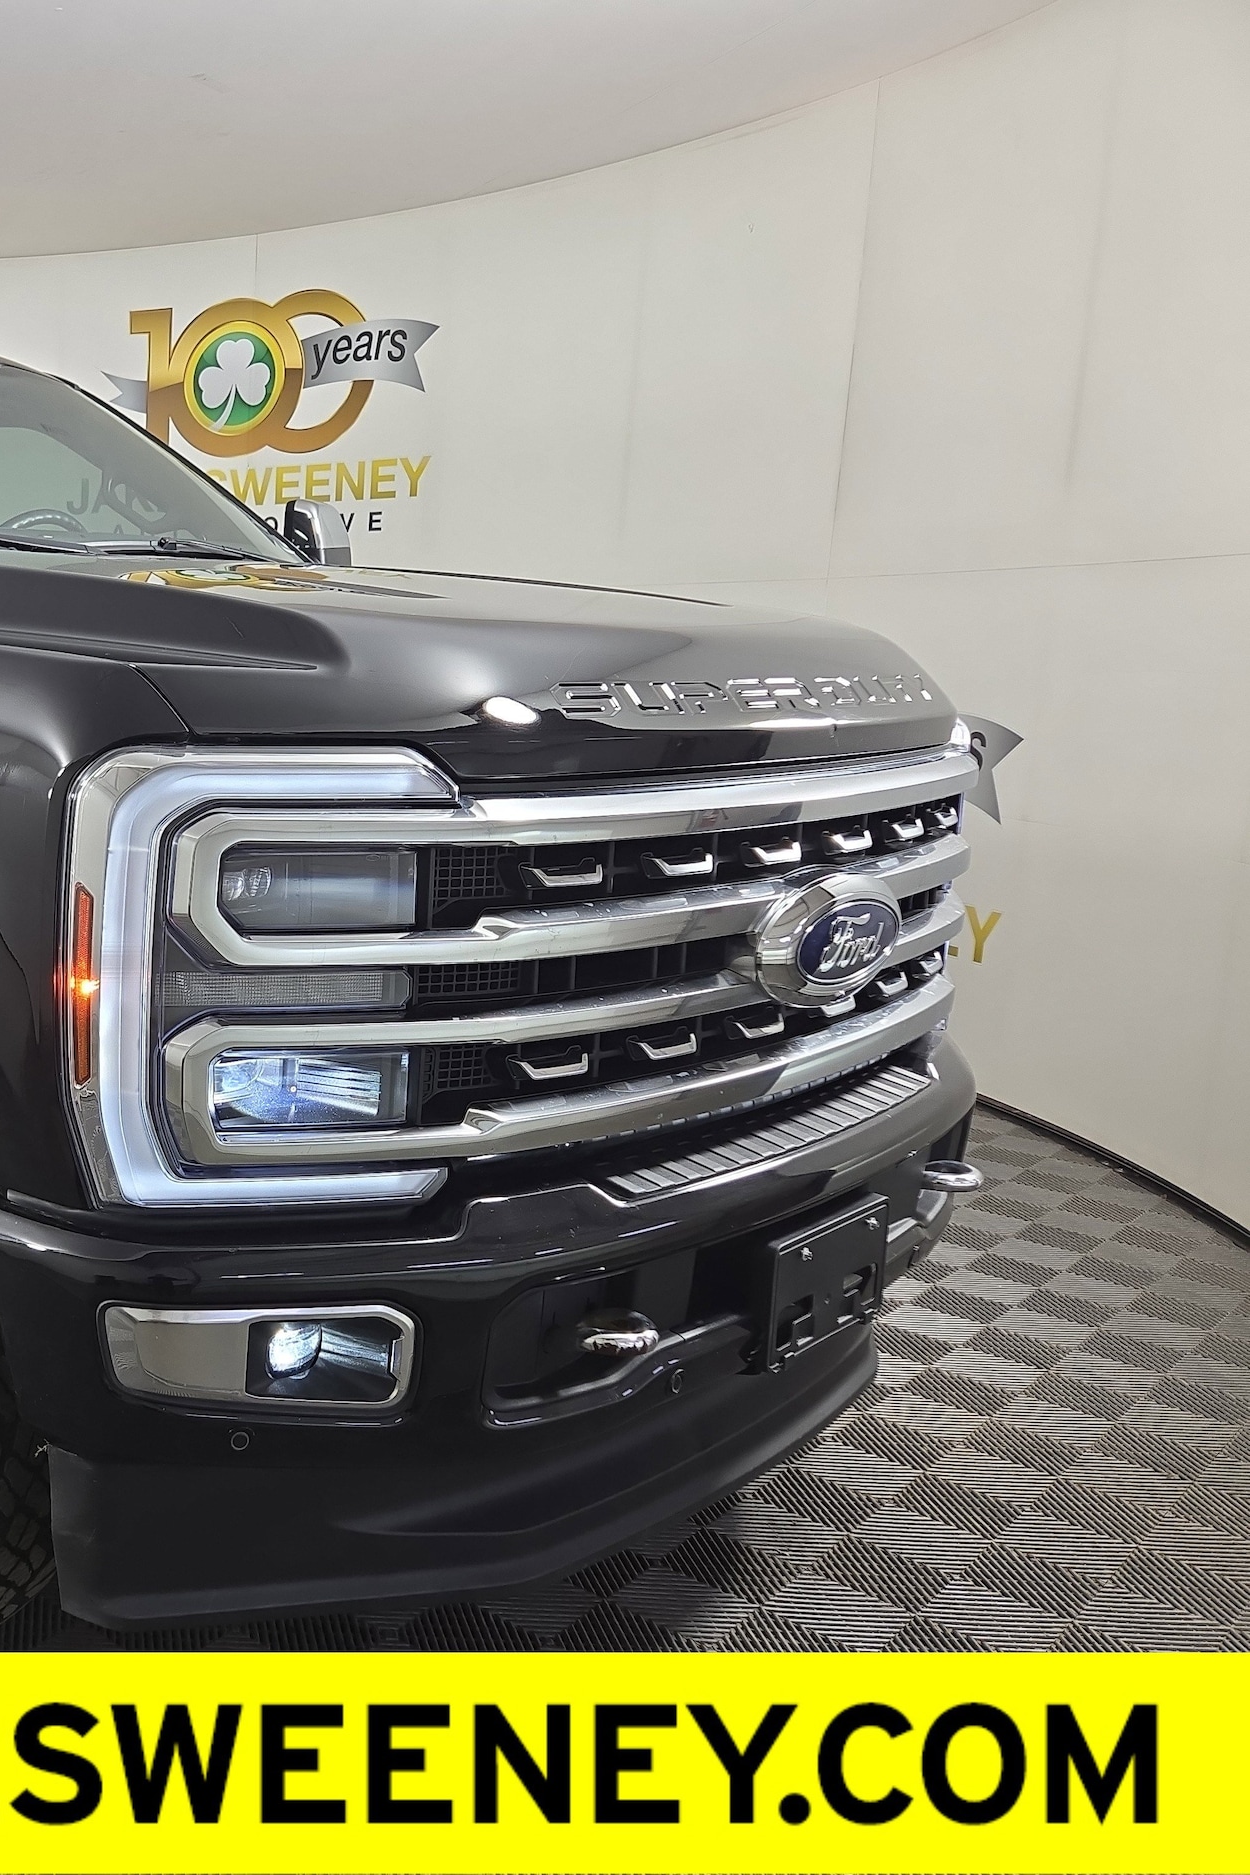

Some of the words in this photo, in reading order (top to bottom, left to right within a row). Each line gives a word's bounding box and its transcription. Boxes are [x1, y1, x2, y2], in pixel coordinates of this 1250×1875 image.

[310, 327, 408, 380] years
[550, 676, 821, 719] SUPER
[818, 912, 884, 974] Ford
